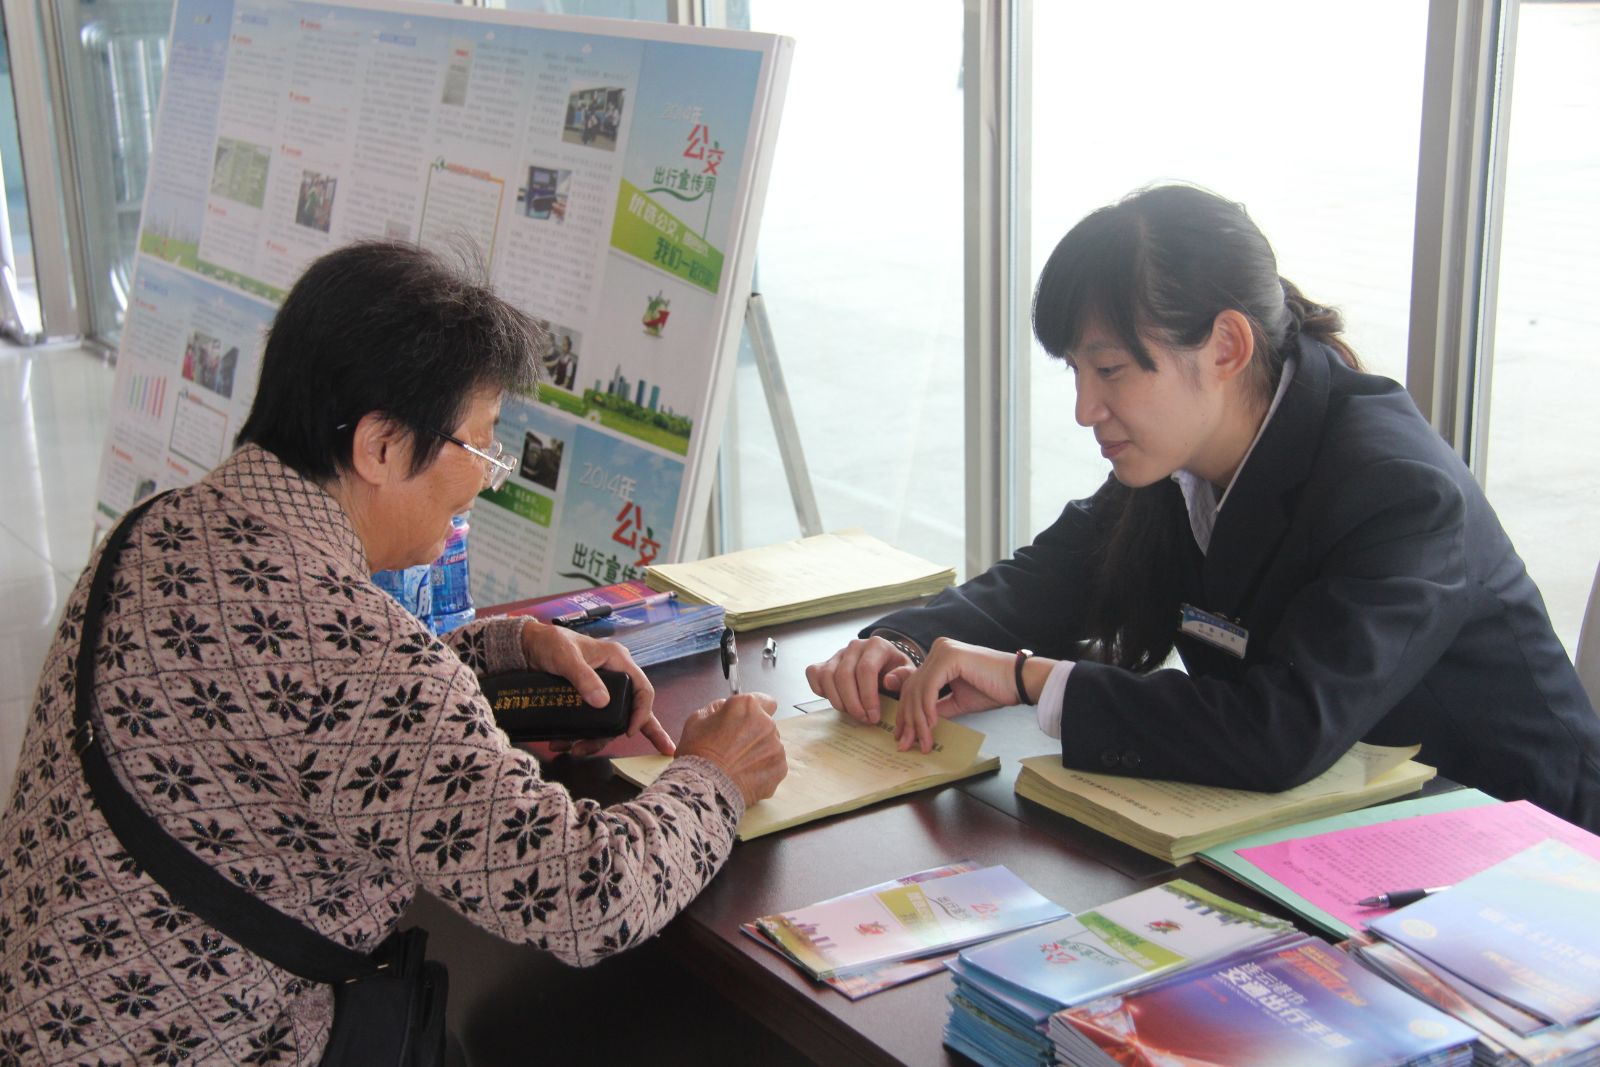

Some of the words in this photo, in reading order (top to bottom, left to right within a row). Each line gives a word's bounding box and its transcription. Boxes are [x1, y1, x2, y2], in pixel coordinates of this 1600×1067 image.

[683, 124, 725, 176] 公交
[579, 462, 637, 499] 2014年
[612, 501, 661, 567] 公交
[572, 541, 648, 584] 出行宣传
